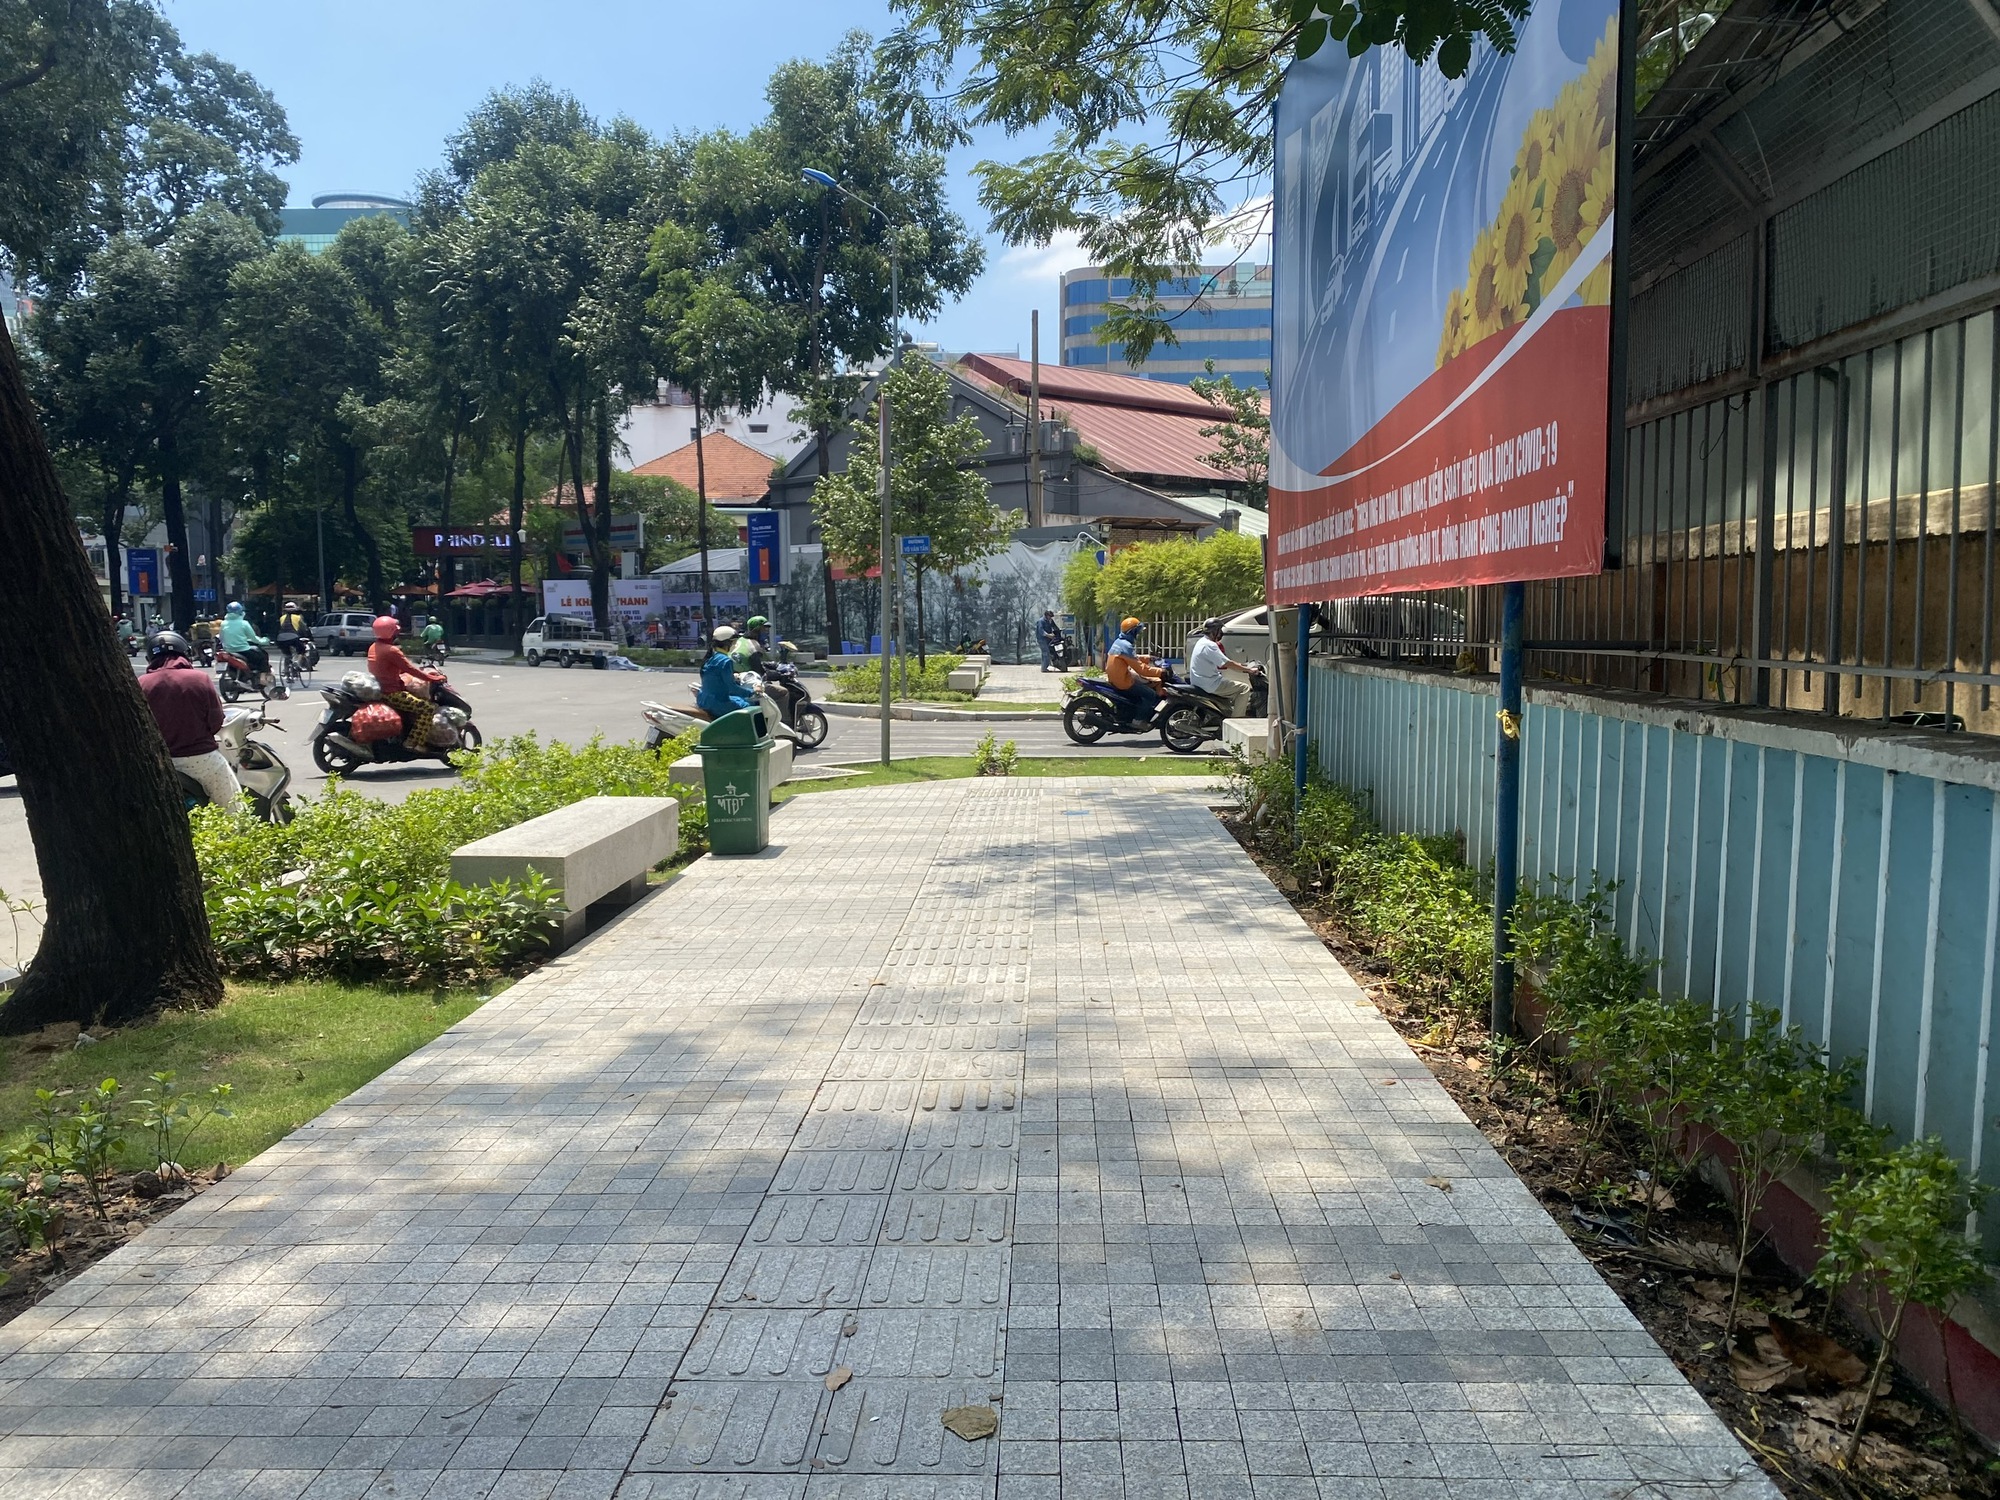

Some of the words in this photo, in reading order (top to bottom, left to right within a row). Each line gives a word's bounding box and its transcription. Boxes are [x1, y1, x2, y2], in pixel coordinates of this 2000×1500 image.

[1428, 457, 1443, 508] KIỂM
[1444, 455, 1460, 502] SOÁT
[1461, 448, 1477, 502] HIỆU
[1479, 433, 1493, 494] QUẢ
[1495, 438, 1514, 492] DỊCH
[1516, 420, 1558, 477] COVID-19
[1441, 514, 1458, 562] ĐỒNG
[1459, 513, 1478, 559] HÀNH
[1480, 507, 1500, 555] CÙNG
[1501, 504, 1530, 551] DOANH
[1531, 480, 1574, 552] NGHIỆP”
[717, 798, 745, 816] MTĐT
